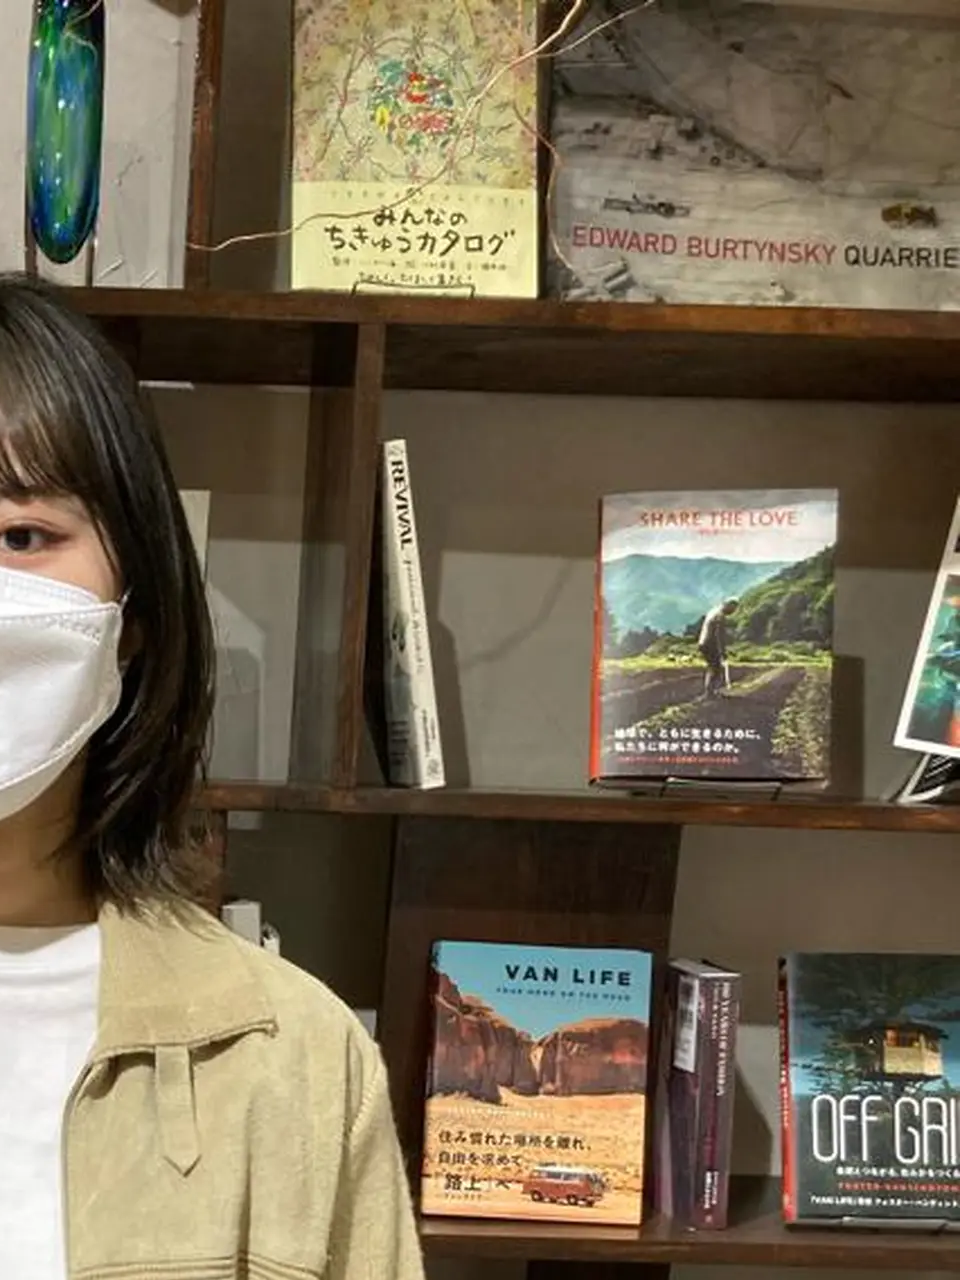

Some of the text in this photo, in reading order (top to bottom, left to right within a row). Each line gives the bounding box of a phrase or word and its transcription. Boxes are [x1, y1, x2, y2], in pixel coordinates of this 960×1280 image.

[372, 206, 468, 227] みんなの
[324, 225, 516, 256] ちきゅうカタログ
[572, 226, 677, 255] EDWARD
[687, 236, 836, 265] BURTYNSKY
[391, 460, 414, 551] REVIVAL
[640, 511, 798, 527] SHARE THE LOVE
[505, 964, 631, 986] VAN LIFE
[812, 1094, 882, 1162] OFF
